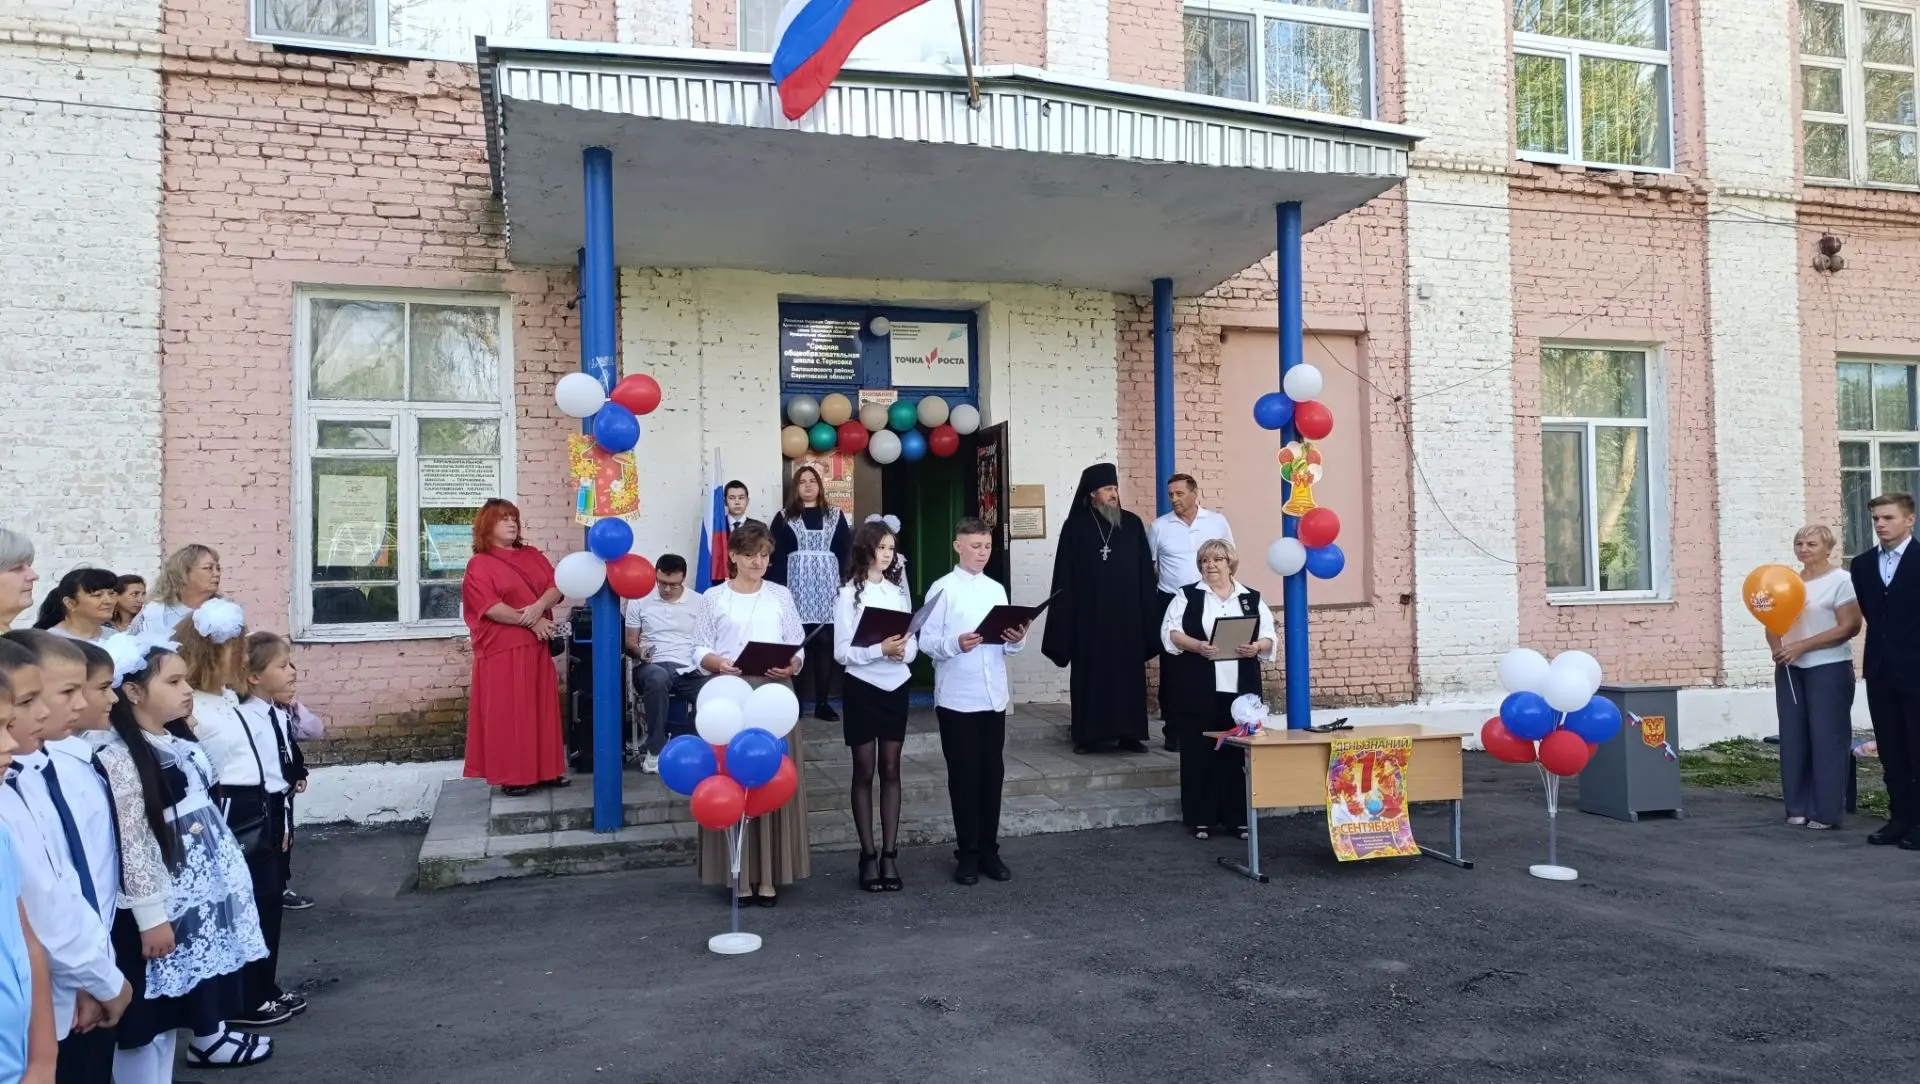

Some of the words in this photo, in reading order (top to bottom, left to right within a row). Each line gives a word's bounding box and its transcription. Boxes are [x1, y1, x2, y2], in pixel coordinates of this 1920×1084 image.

[784, 349, 860, 358] общеобразовательная
[1336, 741, 1362, 752] ДЕНЬ
[1363, 738, 1408, 750] ЗНАНИЙ
[1356, 752, 1376, 793] 1
